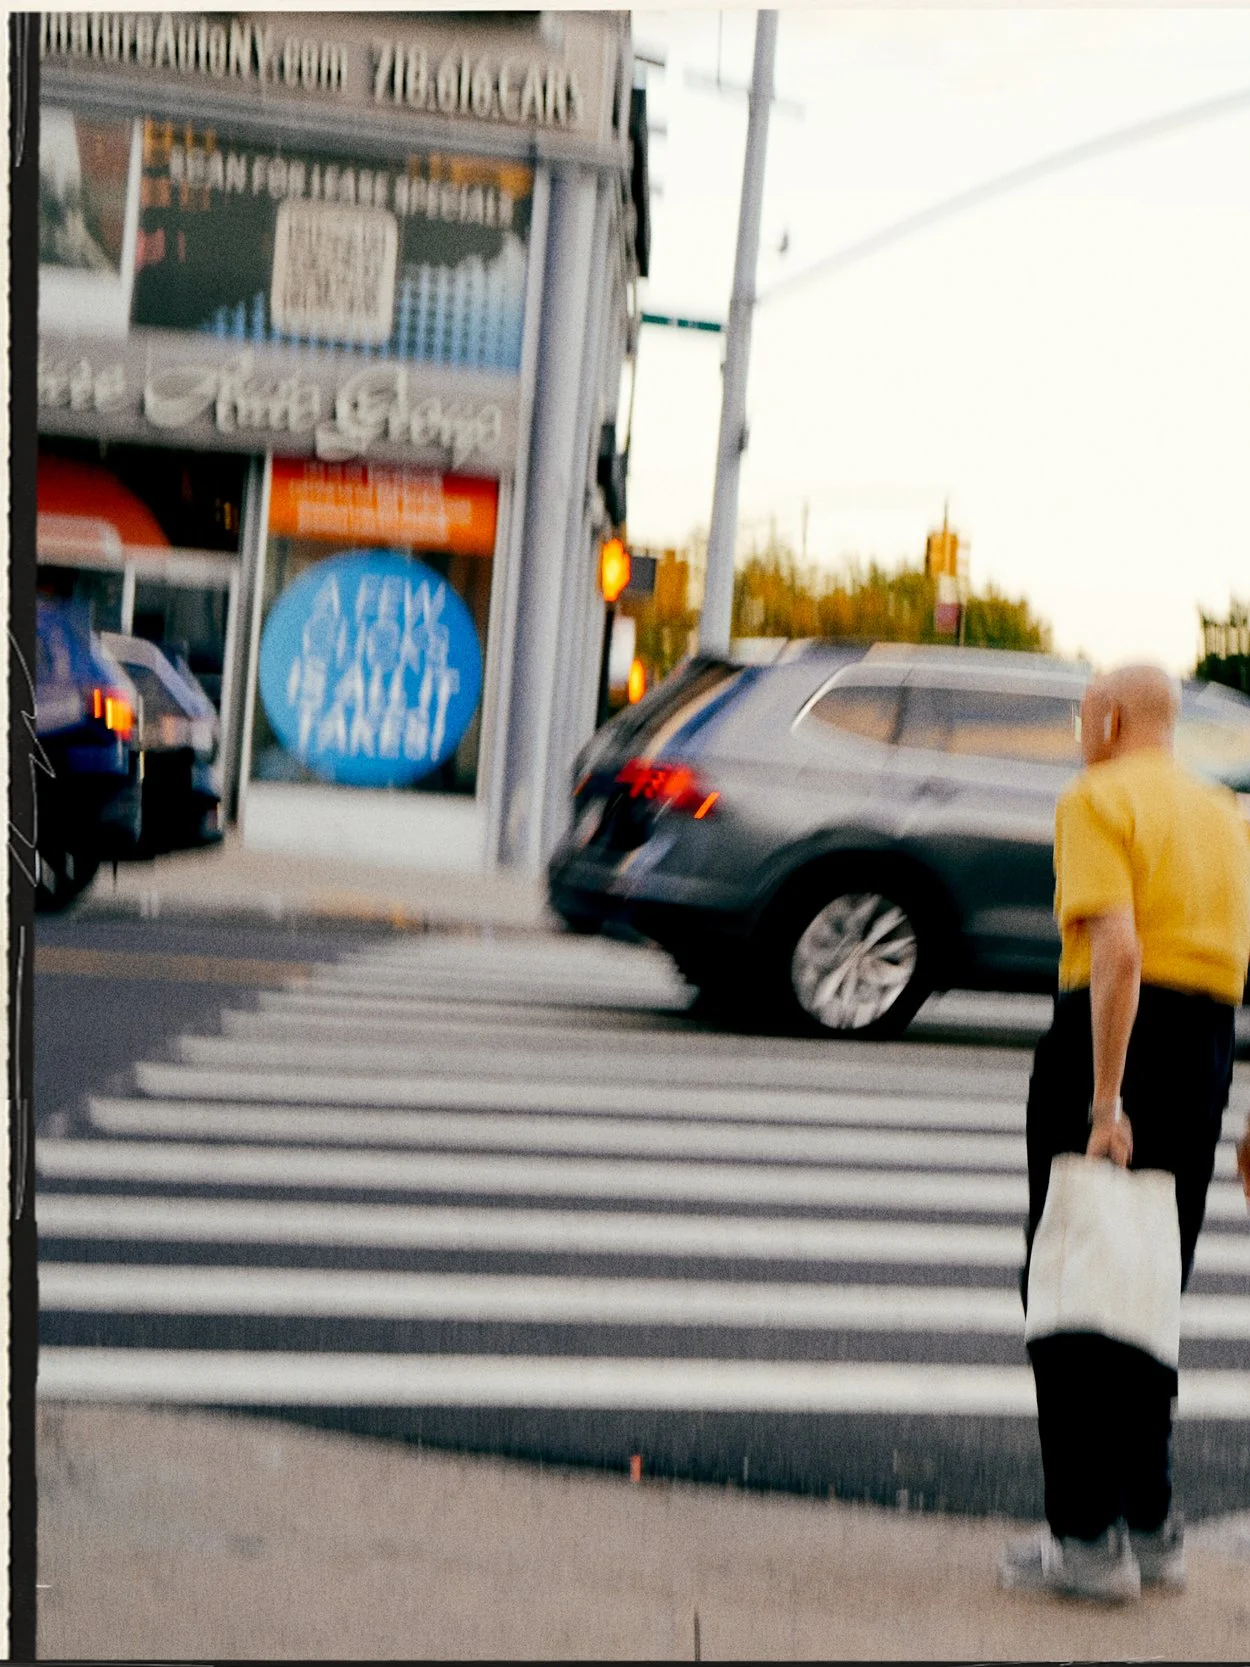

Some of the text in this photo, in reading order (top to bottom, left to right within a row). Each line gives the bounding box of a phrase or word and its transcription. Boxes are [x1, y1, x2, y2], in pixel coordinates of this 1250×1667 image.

[371, 36, 585, 124] 718.616.CARS
[252, 153, 306, 201] FOR
[312, 573, 447, 624] A FEW
